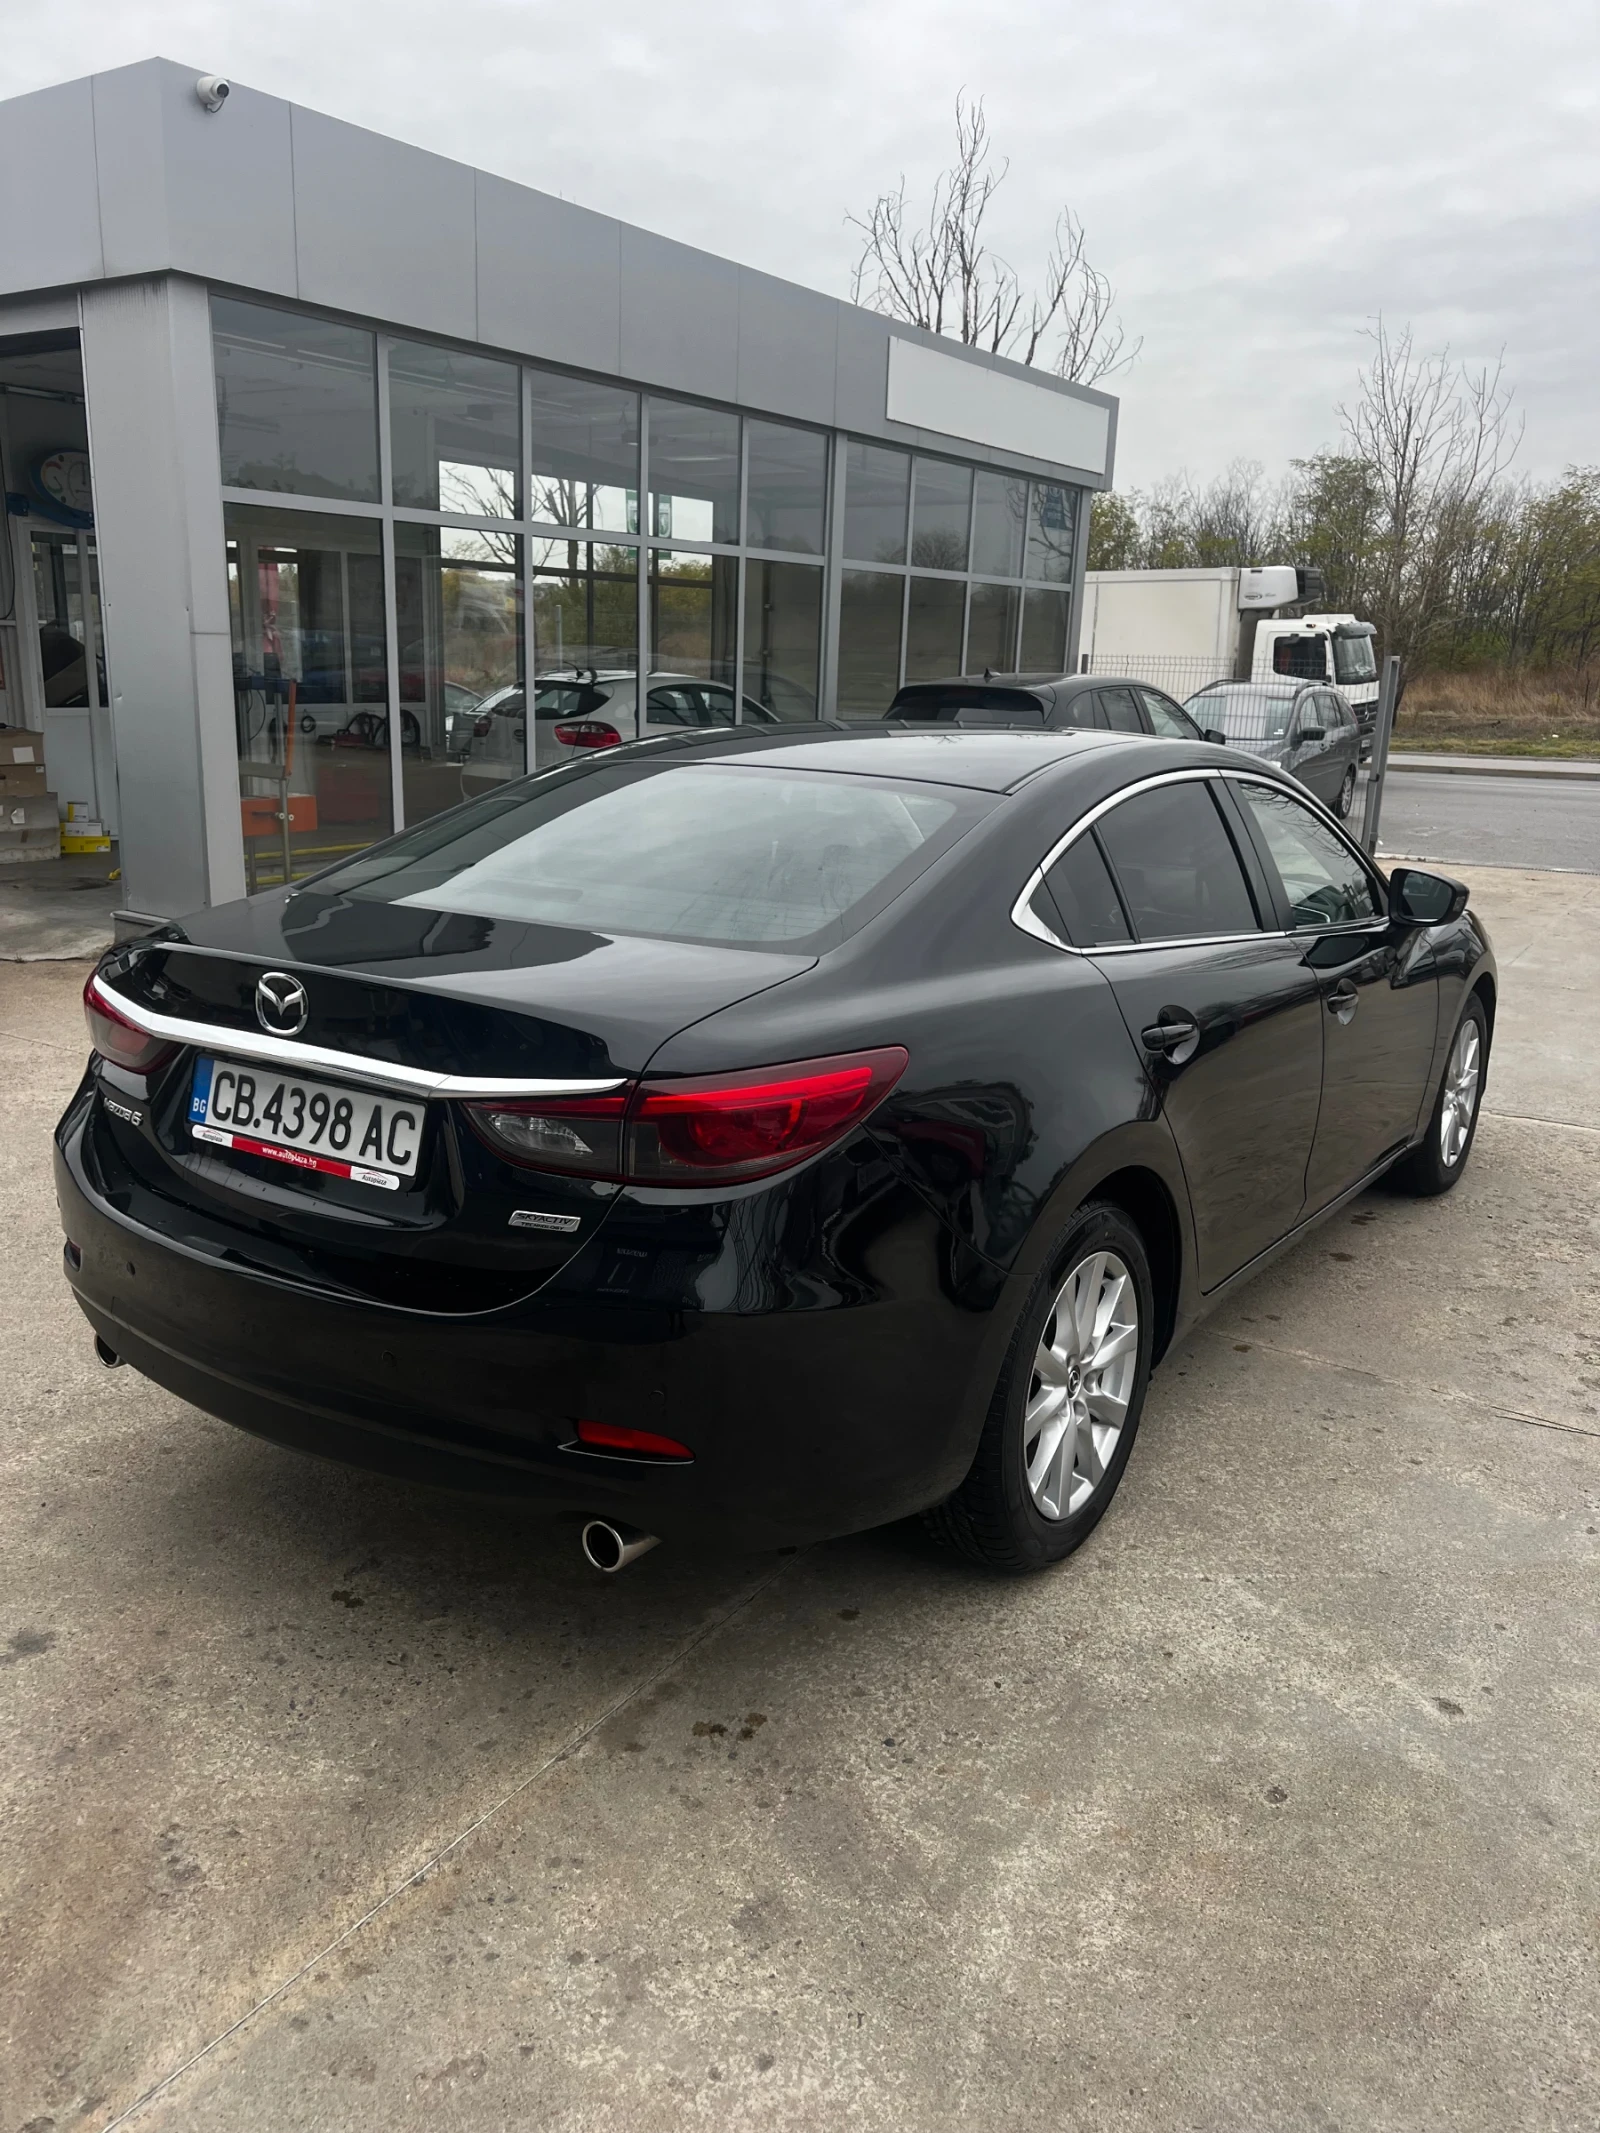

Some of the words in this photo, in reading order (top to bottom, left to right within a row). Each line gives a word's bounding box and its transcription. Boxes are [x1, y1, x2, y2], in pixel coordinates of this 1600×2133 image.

[192, 1097, 207, 1114] BG
[358, 1104, 416, 1166] AC
[516, 1213, 573, 1225] SKYACTIV
[521, 1221, 565, 1231] TECHNOLOGY
